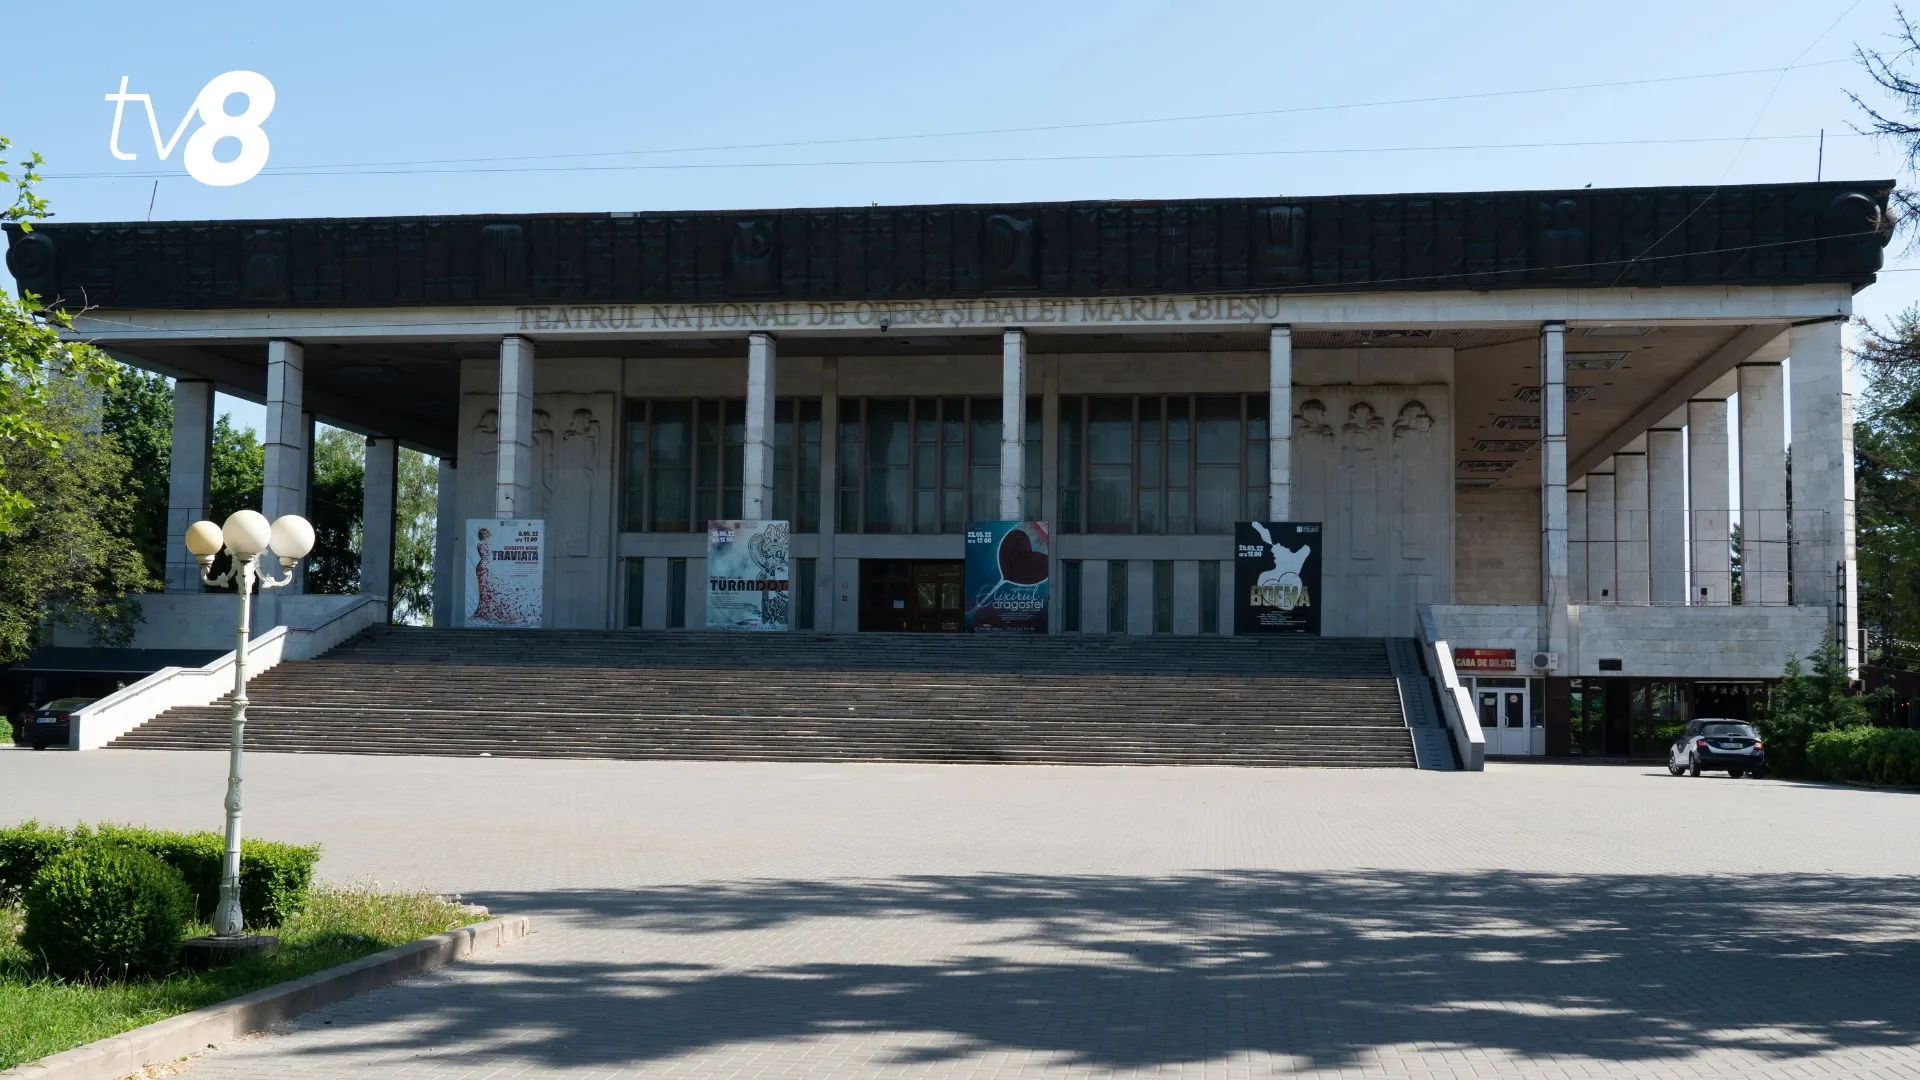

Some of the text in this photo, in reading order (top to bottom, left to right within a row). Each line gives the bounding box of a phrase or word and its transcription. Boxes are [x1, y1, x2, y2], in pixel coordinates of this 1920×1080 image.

[516, 306, 644, 330] TEATRUL
[807, 302, 846, 326] DE
[981, 299, 1074, 323] BALET
[1080, 297, 1181, 322] MARIA
[492, 551, 539, 560] TRAVIATA
[710, 580, 787, 591] TURANDOT
[1250, 585, 1311, 607] BOEMA
[992, 599, 1044, 611] dragostei
[1456, 658, 1516, 667] CASA DE BILETE
